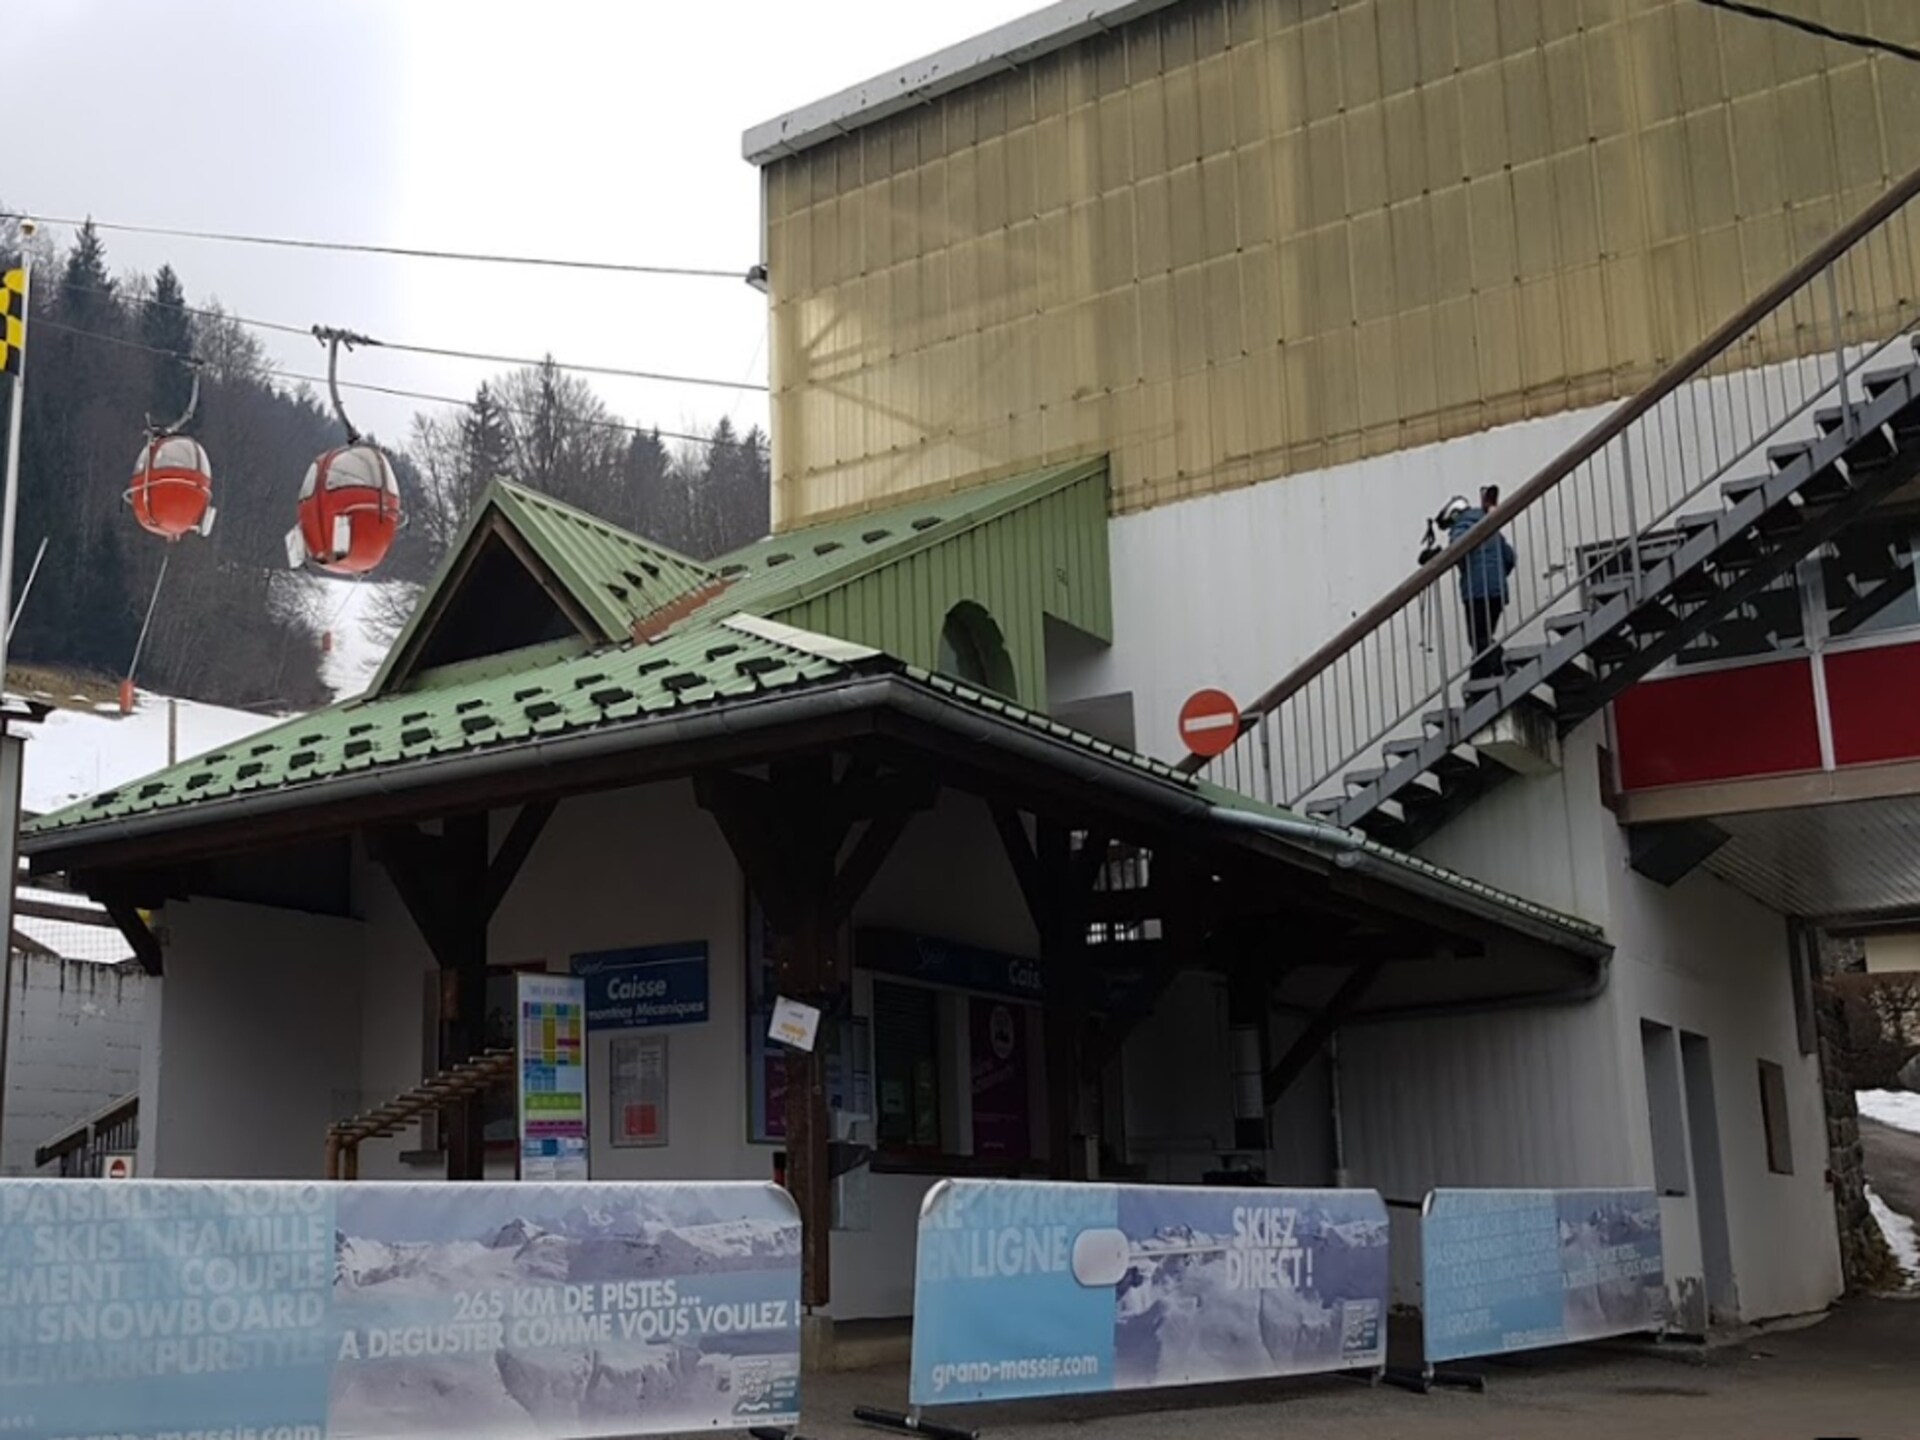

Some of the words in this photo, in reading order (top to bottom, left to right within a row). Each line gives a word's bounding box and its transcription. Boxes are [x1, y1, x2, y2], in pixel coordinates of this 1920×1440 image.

[607, 974, 667, 1000] Caisse
[635, 998, 705, 1019] Mécaniques
[3, 1184, 169, 1225] PAISIBLE
[224, 1184, 326, 1217] SOLO
[33, 1221, 120, 1263] SKIS
[177, 1215, 326, 1258] FAMILLE
[1232, 1206, 1299, 1248] SKIEZ
[970, 1225, 1068, 1278] LIGNE
[1226, 1249, 1304, 1290] DIRECT
[181, 1252, 326, 1295] COUPLE
[36, 1290, 324, 1344] SNOWBOARD
[453, 1291, 504, 1323] 265
[512, 1287, 556, 1318] KM
[564, 1284, 595, 1313] DE
[338, 1332, 361, 1361] A
[367, 1321, 504, 1359] DEGUSTER
[513, 1313, 612, 1350] COMME
[620, 1305, 690, 1340] VOUS
[696, 1300, 789, 1334] VOULEZ
[155, 1335, 230, 1375] PUR
[931, 1352, 1099, 1391] grand-massif.com
